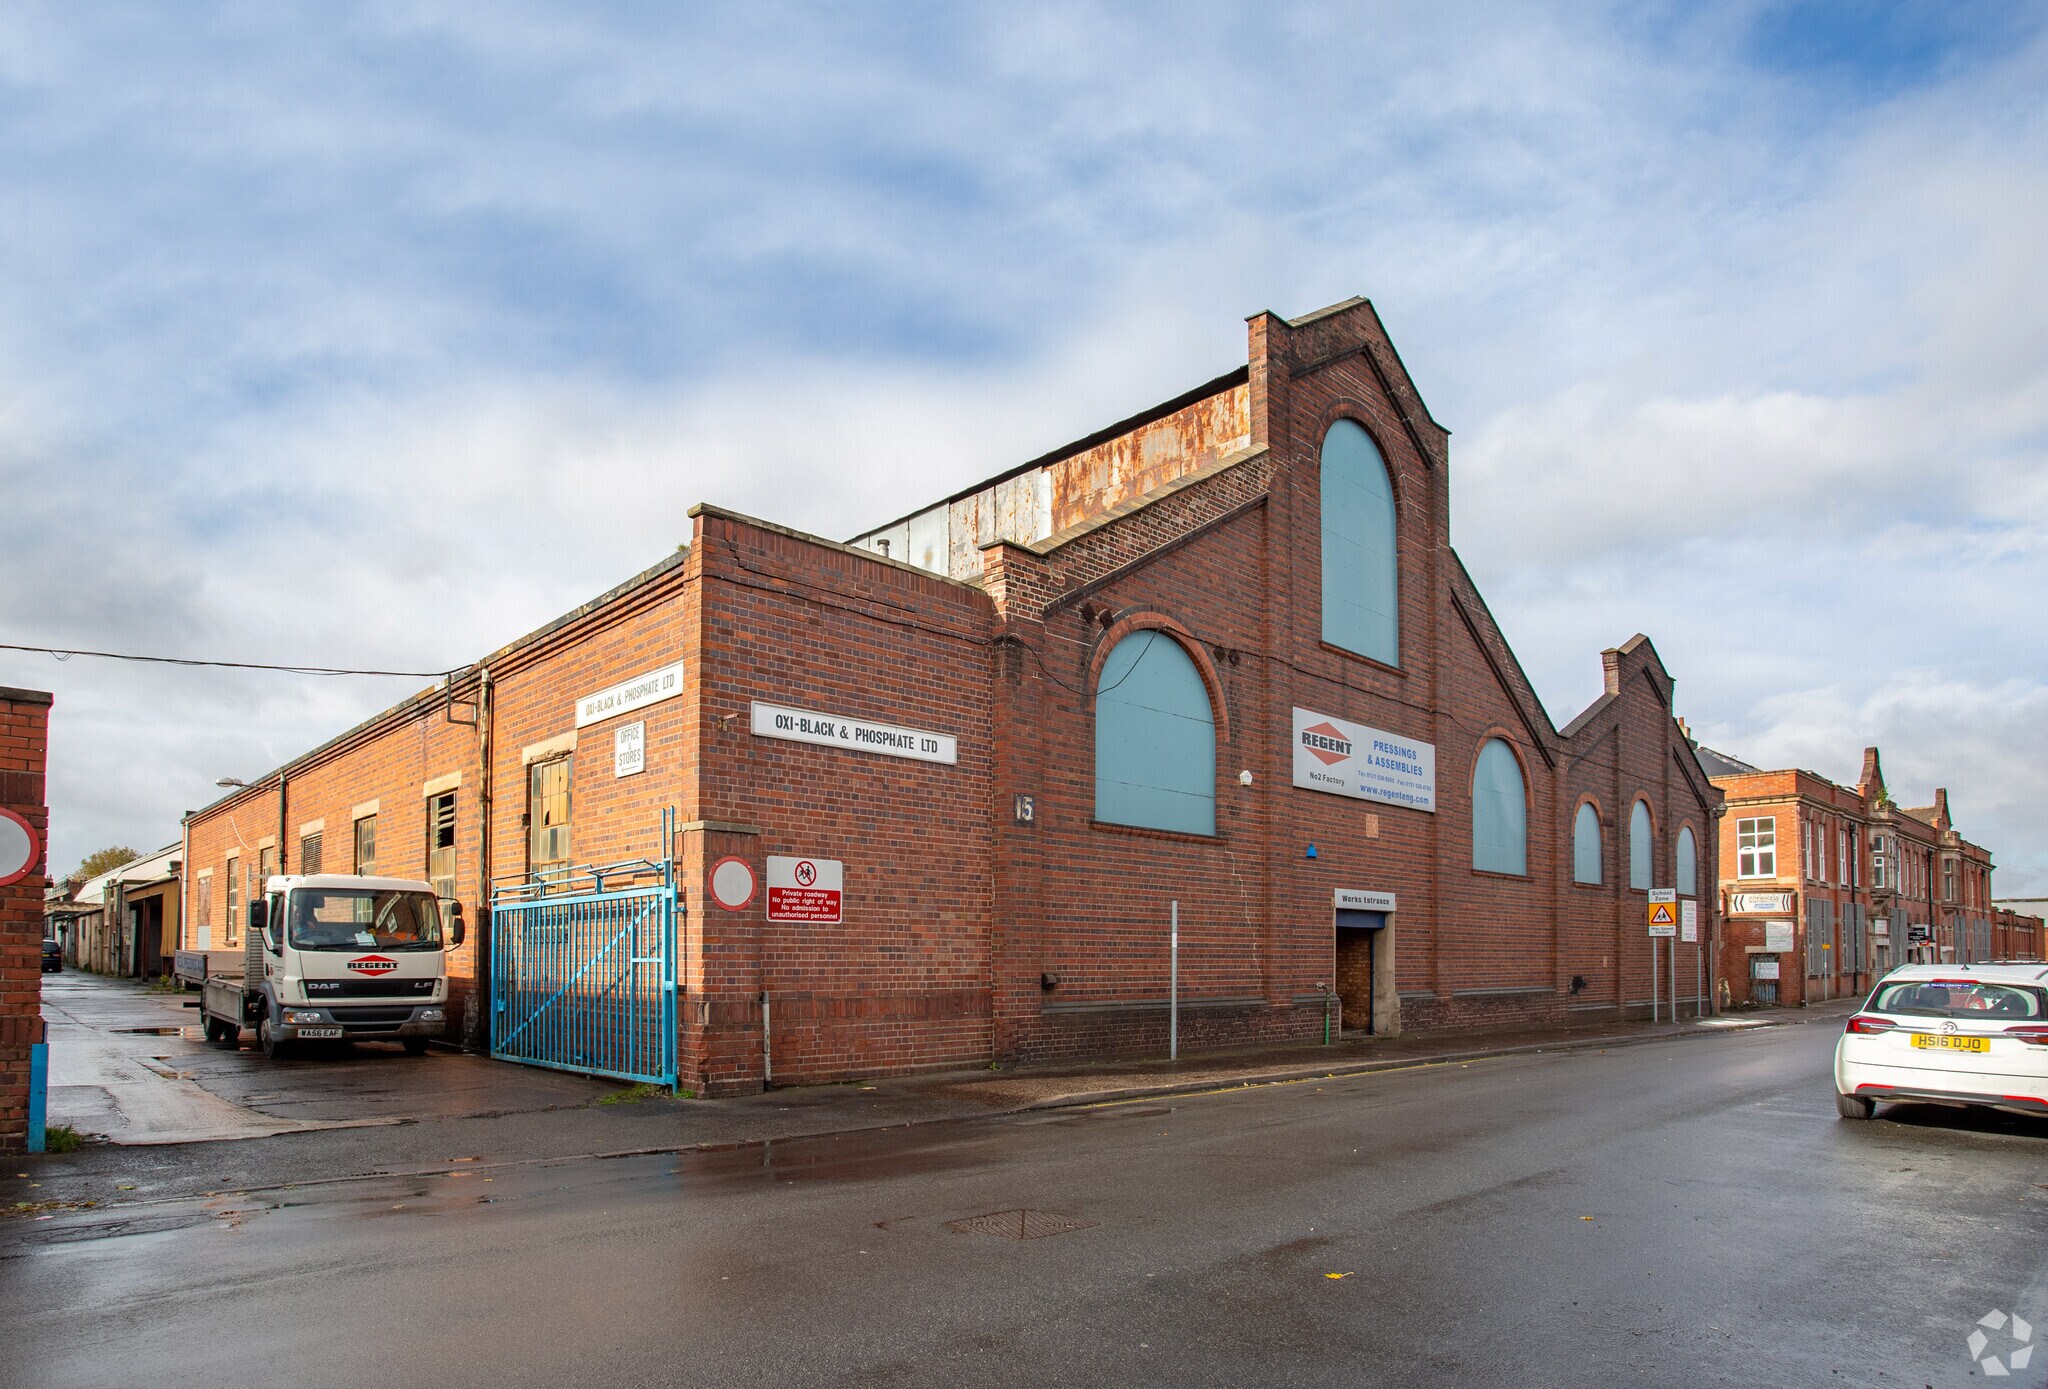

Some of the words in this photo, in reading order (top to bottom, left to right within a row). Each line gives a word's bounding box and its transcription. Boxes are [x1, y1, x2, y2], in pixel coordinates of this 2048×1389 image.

[616, 694, 622, 705] &
[624, 678, 658, 703] PHOSPHATE
[662, 673, 674, 690] LTD
[620, 726, 640, 744] OFFICE
[775, 714, 835, 738] OXI-BLACK
[839, 725, 849, 740] &
[855, 727, 914, 750] PHOSPHATE
[921, 738, 938, 754] LTD
[1302, 732, 1352, 755] REGENT
[618, 748, 641, 766] STORES
[1373, 740, 1417, 760] PRESSINGS
[1367, 754, 1374, 765] &
[1375, 756, 1423, 776] ASSEMBLIES
[1309, 772, 1322, 781] No2
[1322, 773, 1345, 786] Factory
[1360, 784, 1429, 804] www.regenteng.com
[1016, 796, 1034, 820] 15
[1342, 895, 1362, 903] Works
[1364, 896, 1390, 905] Entrance
[1919, 1036, 1949, 1047] HS16
[1953, 1038, 1981, 1049] DJO
